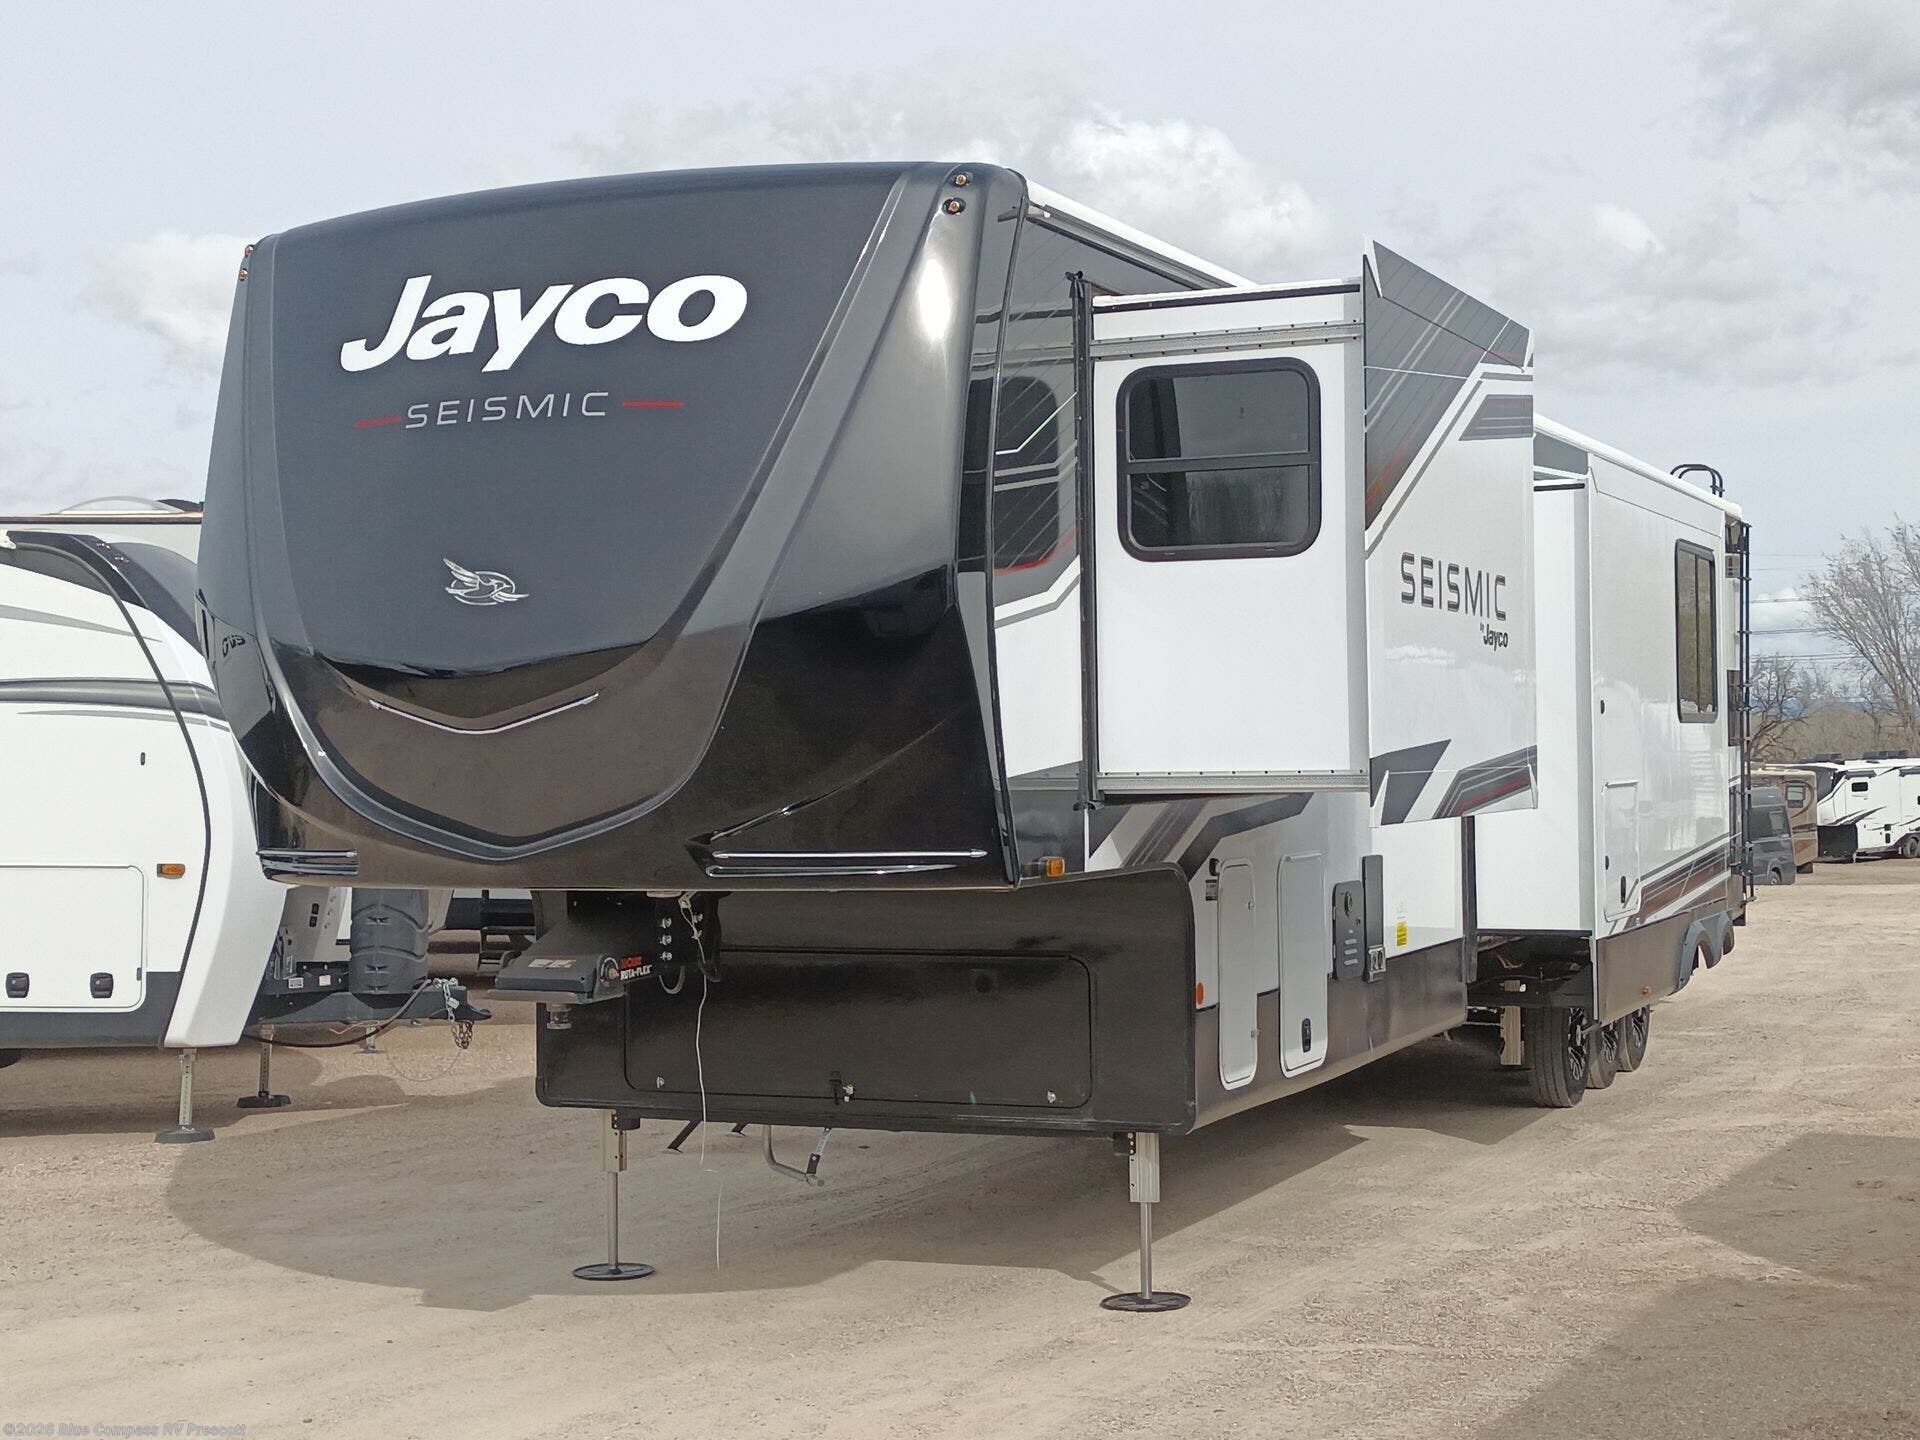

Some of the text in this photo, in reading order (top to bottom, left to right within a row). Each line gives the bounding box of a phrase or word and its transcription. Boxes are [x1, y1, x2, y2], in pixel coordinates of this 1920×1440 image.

[340, 274, 748, 372] Jayco
[404, 392, 609, 429] SEISMIC
[1401, 551, 1506, 621] SEISMIC
[1483, 624, 1508, 651] Jayco
